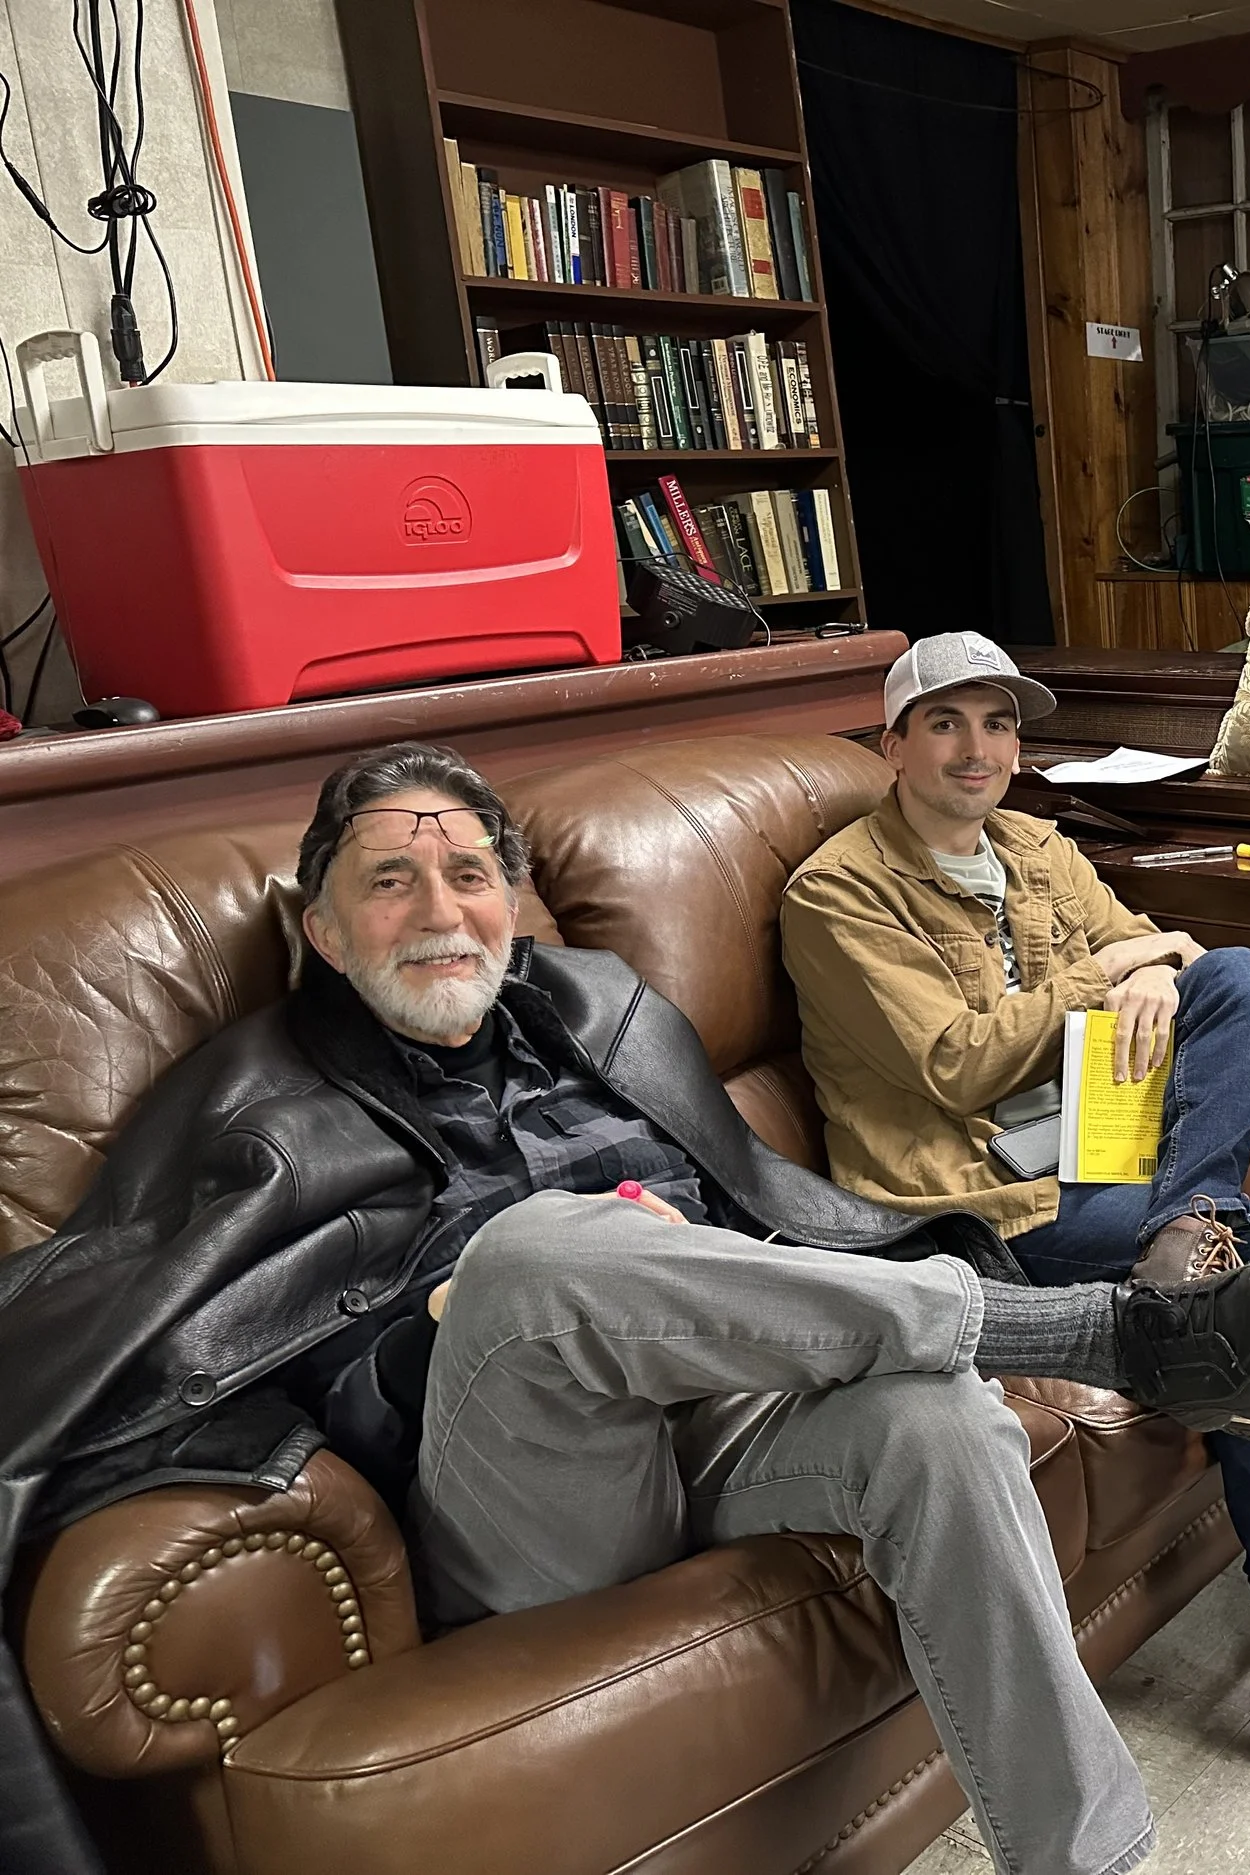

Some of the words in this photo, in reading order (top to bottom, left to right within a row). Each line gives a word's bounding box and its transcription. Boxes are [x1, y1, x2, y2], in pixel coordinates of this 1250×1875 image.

[570, 205, 578, 238] LONDON
[788, 367, 801, 425] ECONOMICS
[667, 480, 697, 536] MILLER'S
[404, 520, 464, 541] IGLOO
[736, 537, 753, 572] LACE
